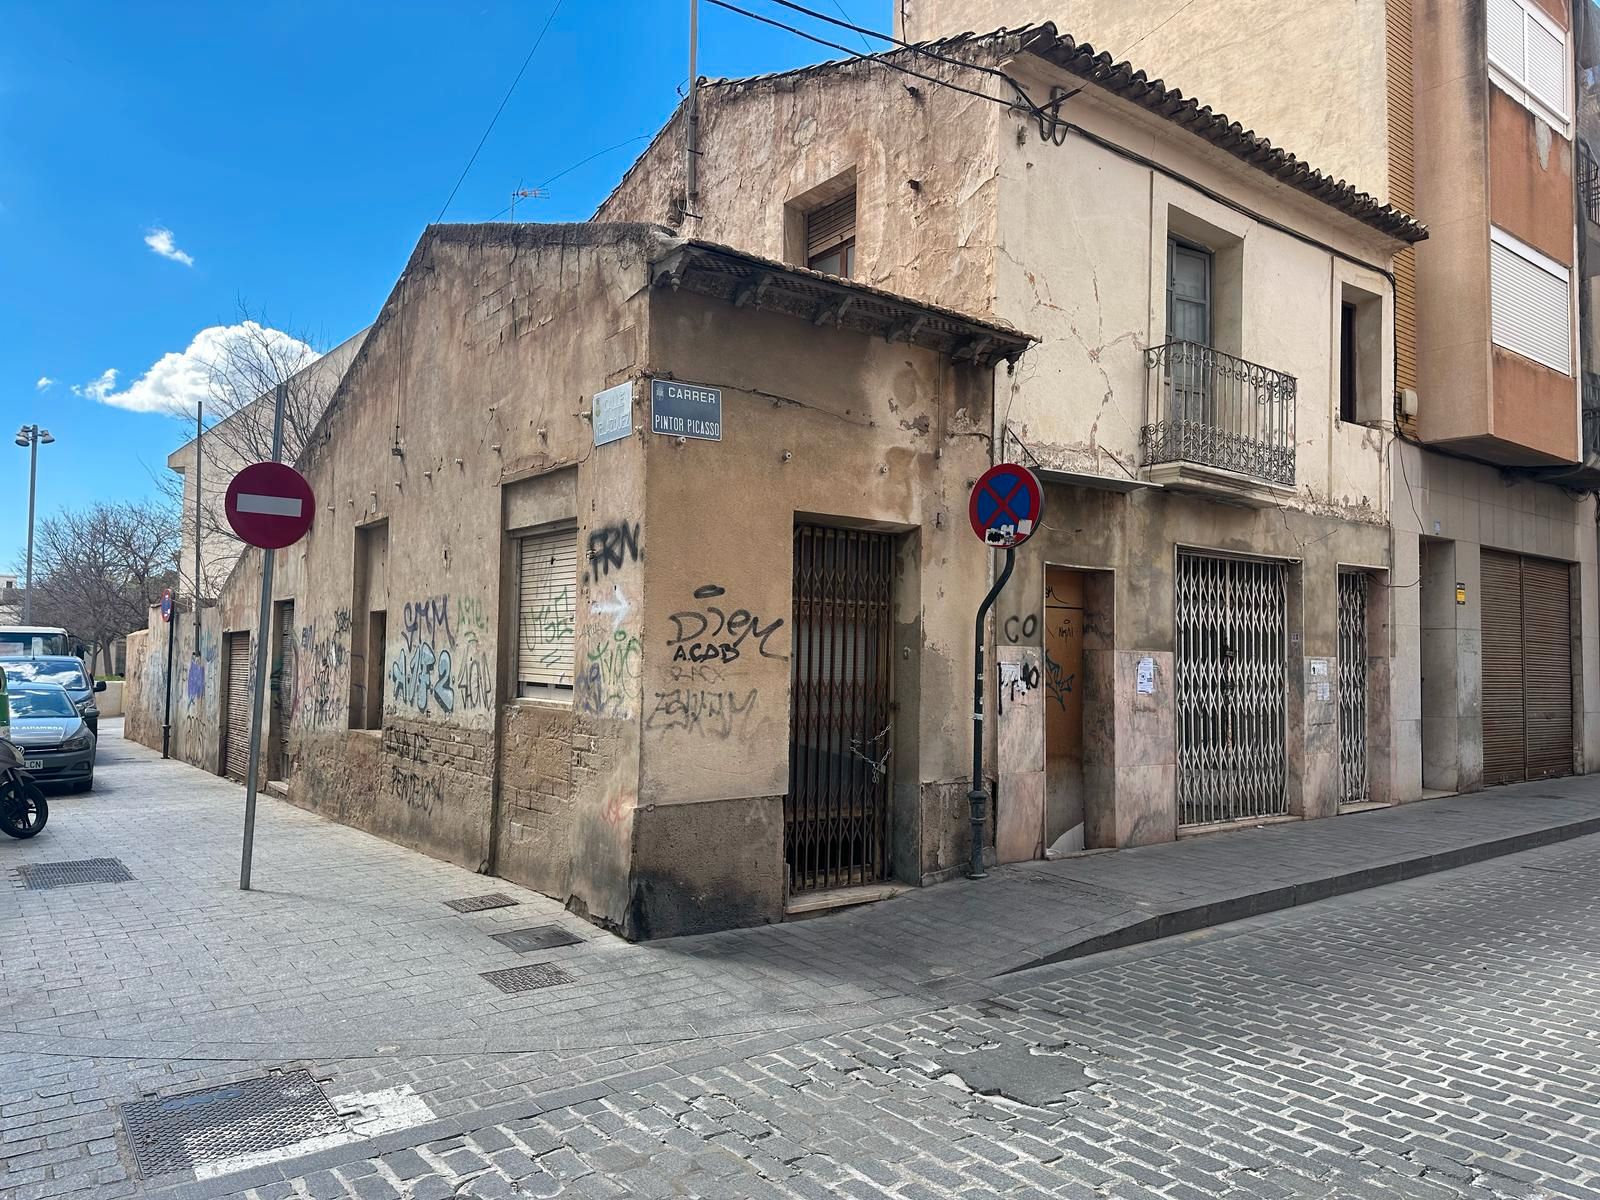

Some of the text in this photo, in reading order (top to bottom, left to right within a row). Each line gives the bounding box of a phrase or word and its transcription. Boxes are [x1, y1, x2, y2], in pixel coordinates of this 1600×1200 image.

[668, 387, 716, 404] CARRER
[655, 414, 720, 437] PINTOR PICASSO
